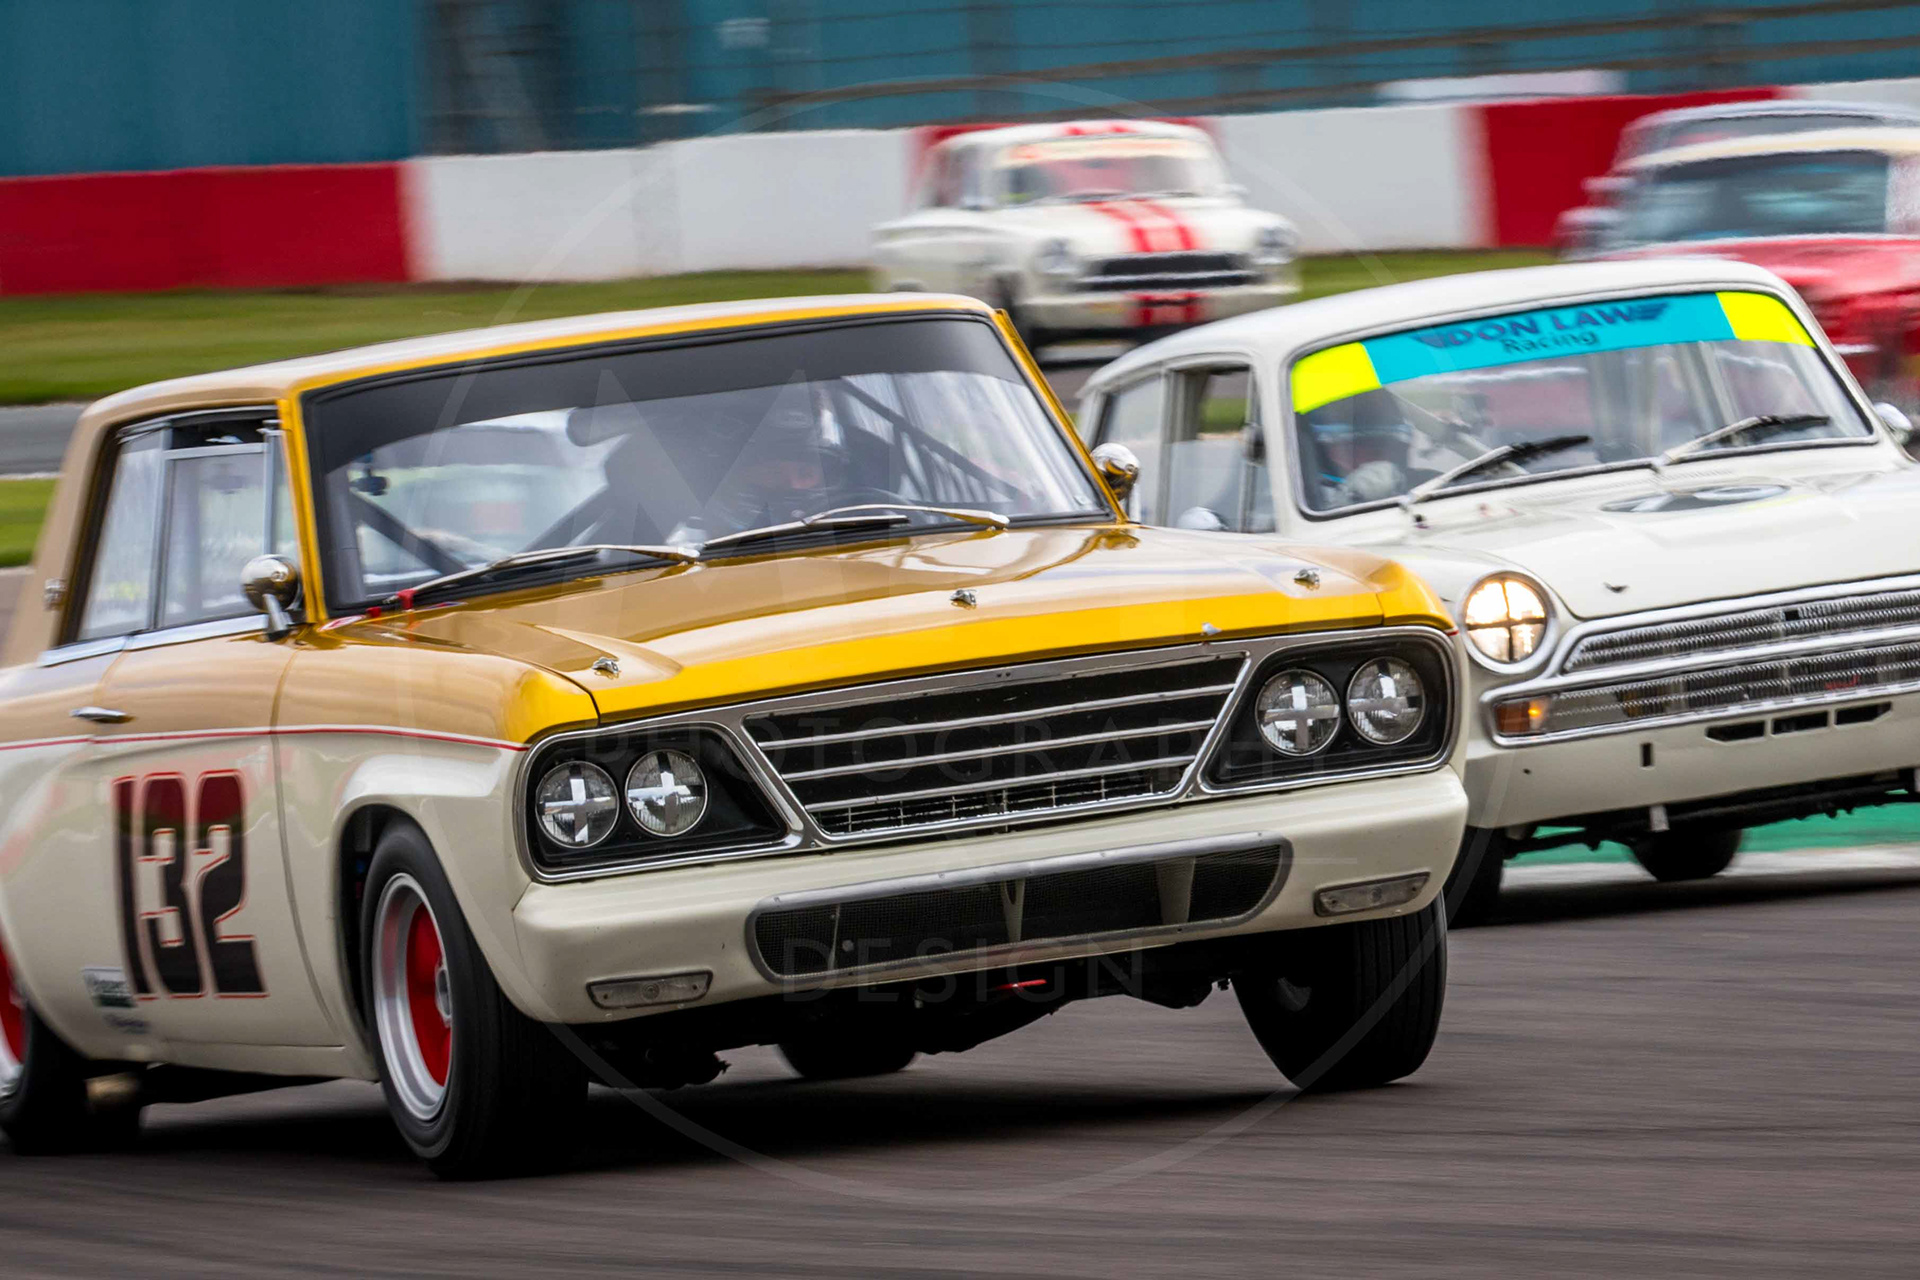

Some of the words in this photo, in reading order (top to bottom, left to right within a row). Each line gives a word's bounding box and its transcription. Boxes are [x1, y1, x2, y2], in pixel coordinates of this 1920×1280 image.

[1449, 315, 1540, 347] DON
[1551, 302, 1632, 331] LAW
[1502, 331, 1599, 355] Racing
[112, 768, 270, 1001] 132
